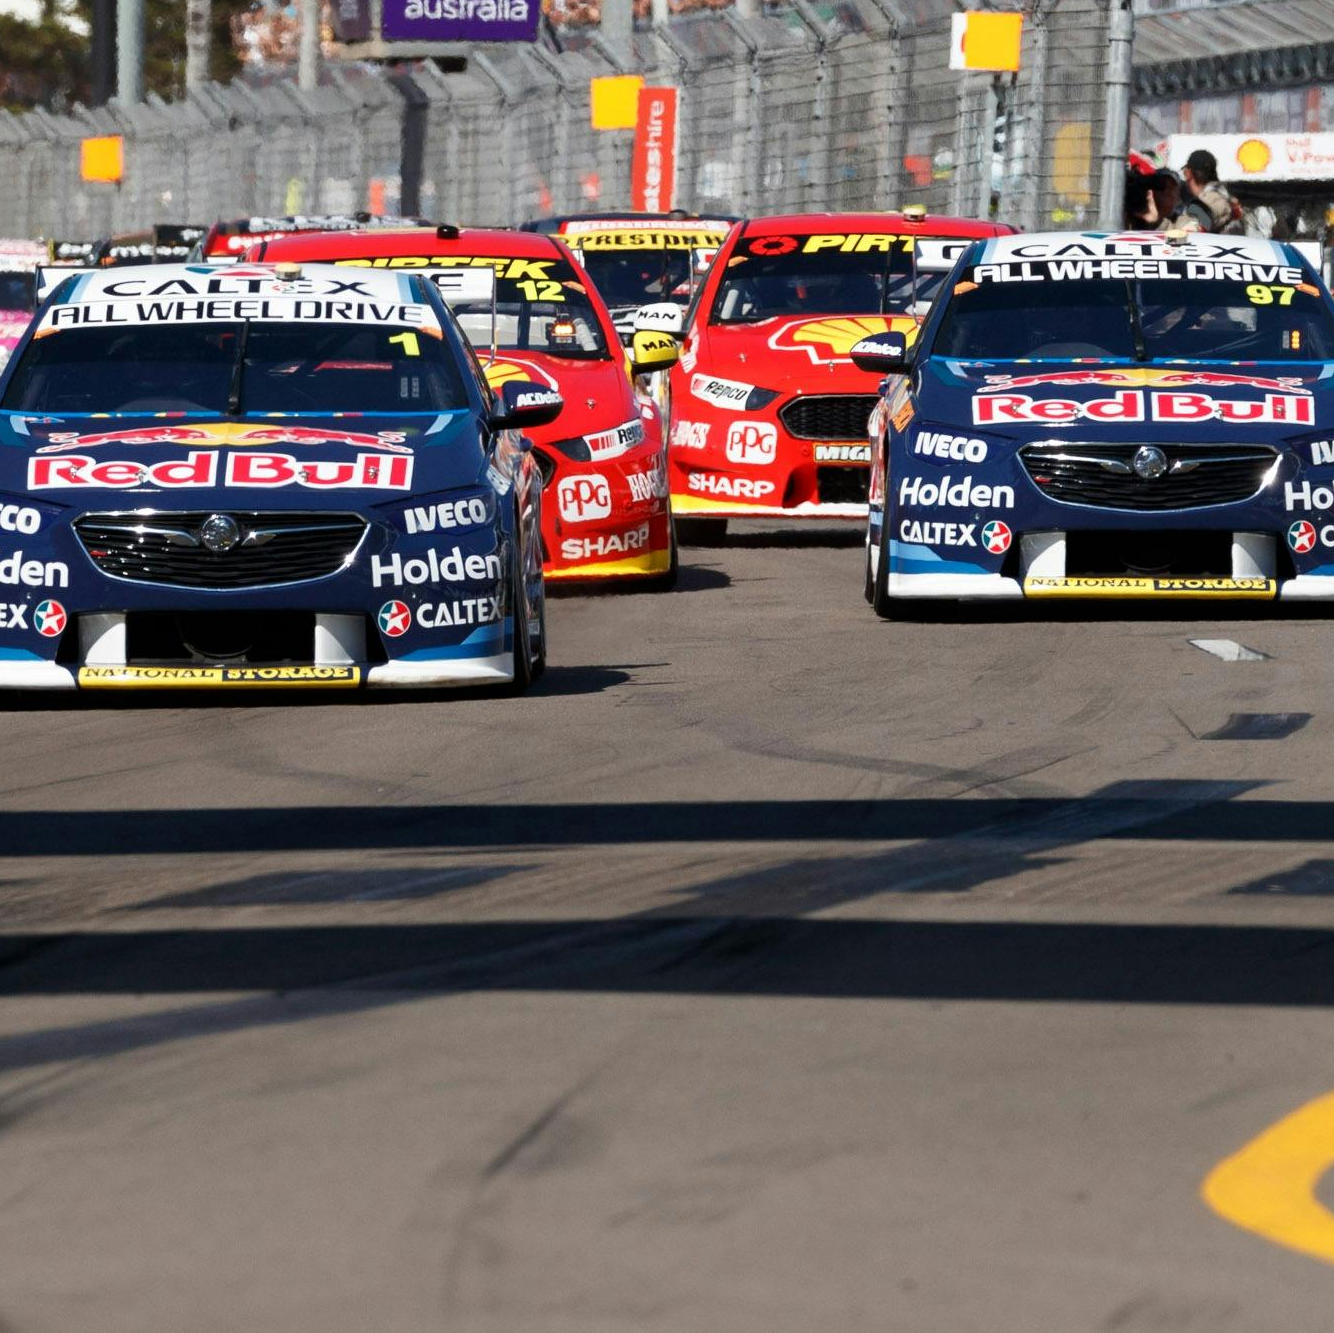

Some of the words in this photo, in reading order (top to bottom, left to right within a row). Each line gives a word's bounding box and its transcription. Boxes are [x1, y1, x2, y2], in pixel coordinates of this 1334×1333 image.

[802, 234, 915, 253] PIRT
[1011, 244, 1253, 261] CALTEX
[973, 263, 1045, 283] ALL
[1047, 260, 1181, 280] WHEEL
[1187, 261, 1303, 284] DRIVE
[101, 278, 377, 297] CALTEX
[516, 280, 566, 301] 12
[1245, 284, 1296, 306] 97
[51, 303, 128, 326] ALL
[136, 300, 284, 321] WHEEL
[293, 301, 424, 323] DRIVE
[637, 310, 678, 321] MAN
[387, 331, 421, 356] 1
[972, 390, 1145, 425] Red
[1151, 391, 1316, 426] Bull
[729, 425, 775, 461] PPG
[914, 431, 988, 463] IVECO
[27, 450, 219, 490] Red
[225, 450, 414, 491] Bull
[561, 479, 610, 517] PPG
[687, 472, 776, 498] SHARP
[899, 475, 1015, 509] Holden
[403, 498, 487, 534] IVECO
[560, 522, 650, 560] SHARP
[900, 519, 977, 546] CALTEX
[370, 546, 501, 587] Holden
[1158, 578, 1268, 590] STORAGE
[416, 596, 502, 629] CALTEX
[227, 666, 350, 679] STORAGE
